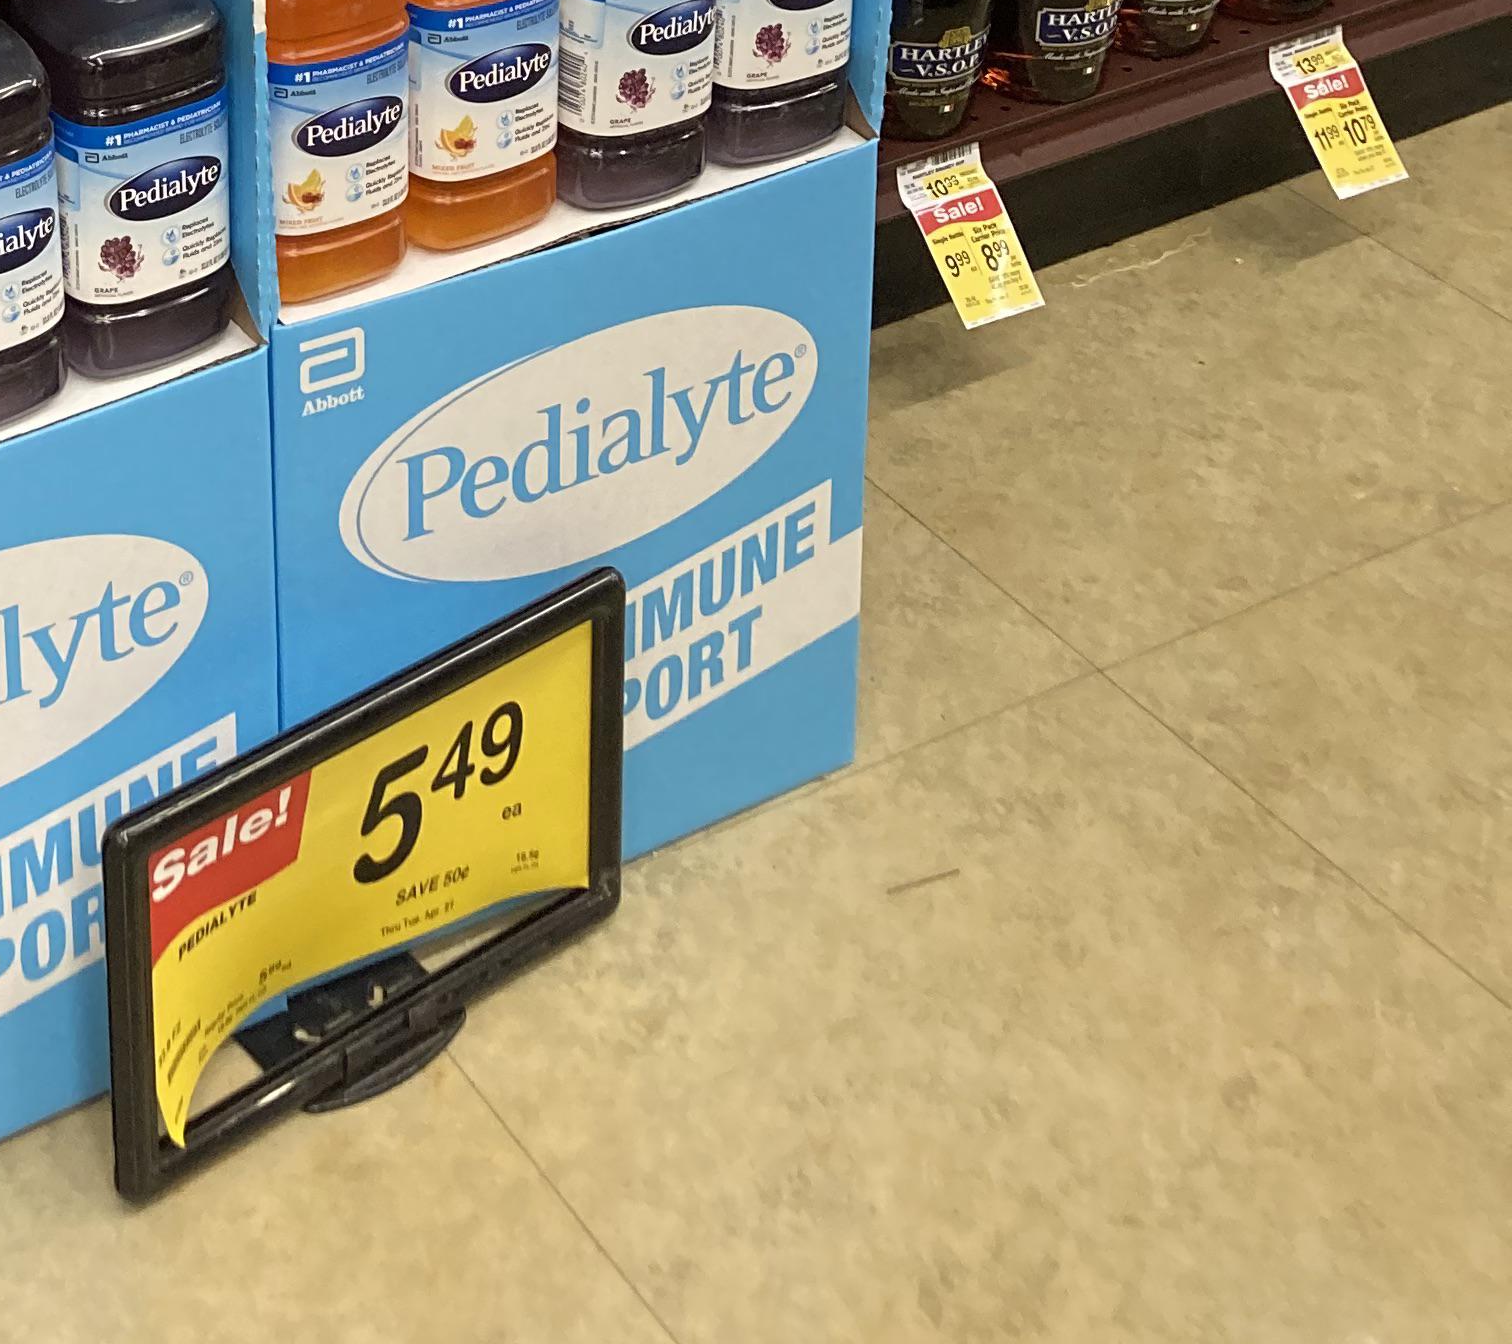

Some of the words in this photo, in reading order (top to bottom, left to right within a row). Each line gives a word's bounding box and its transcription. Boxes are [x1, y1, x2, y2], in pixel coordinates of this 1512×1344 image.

[459, 51, 550, 93] Pedialyte
[1303, 74, 1349, 100] Sale!
[119, 163, 220, 212] Pedialyte
[933, 196, 985, 224] Sale!
[944, 250, 971, 278] 999
[301, 384, 366, 418] Abbott
[394, 351, 796, 542] Pedialyte
[502, 801, 522, 821] ea
[152, 784, 293, 904] Sale!
[395, 874, 439, 906] SAVE
[178, 891, 257, 962] PEDIALYTE
